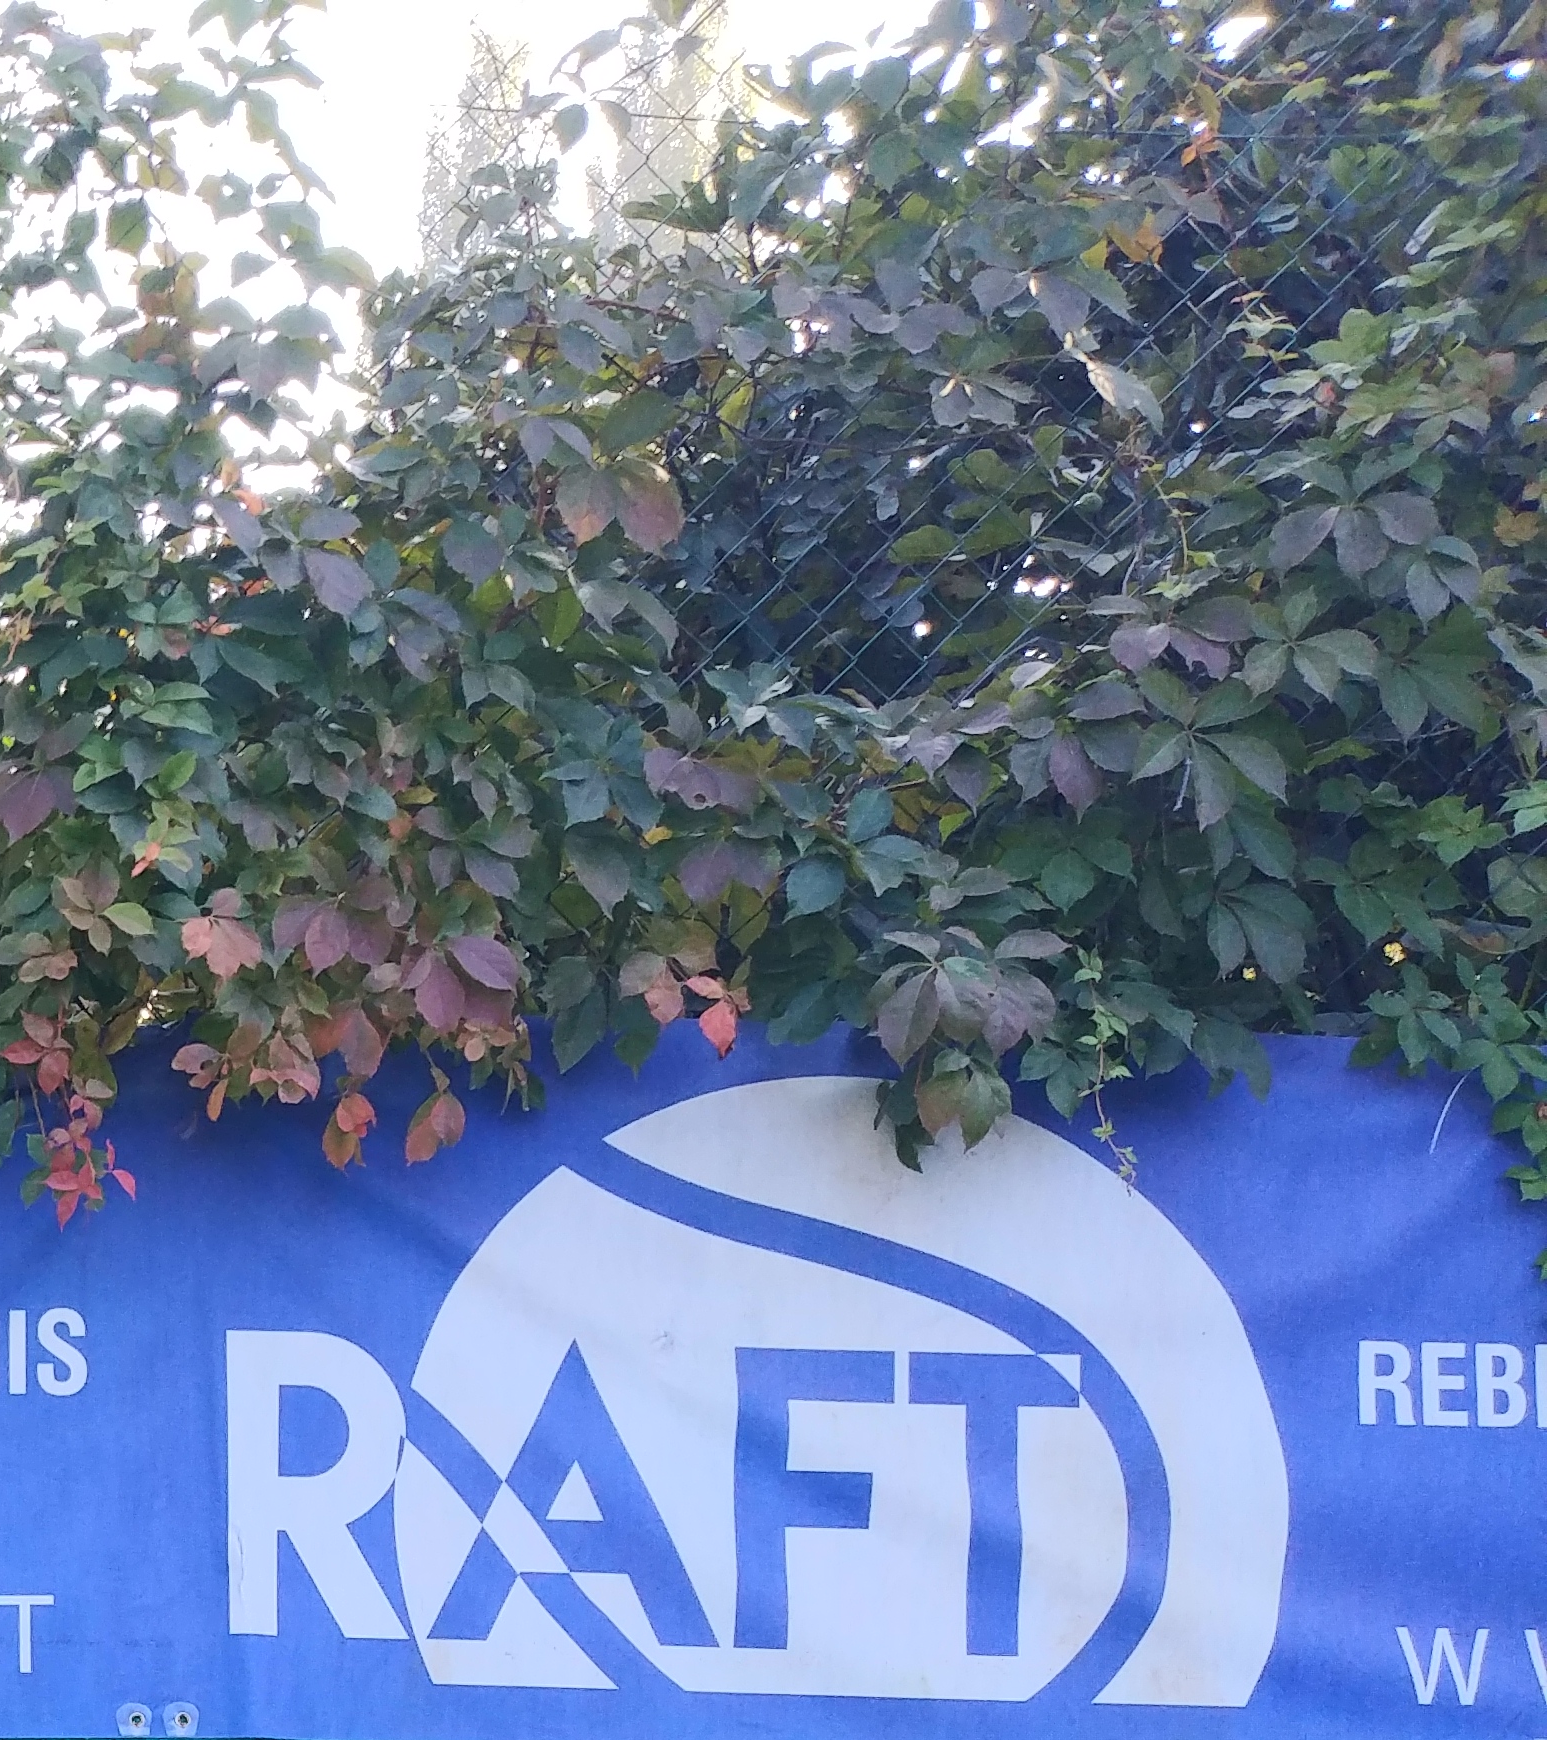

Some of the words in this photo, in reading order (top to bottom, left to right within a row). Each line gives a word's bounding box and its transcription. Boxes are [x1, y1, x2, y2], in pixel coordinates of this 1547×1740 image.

[1358, 1340, 1547, 1429] REB
[226, 1329, 1081, 1657] RAFT
[1395, 1626, 1547, 1706] W
